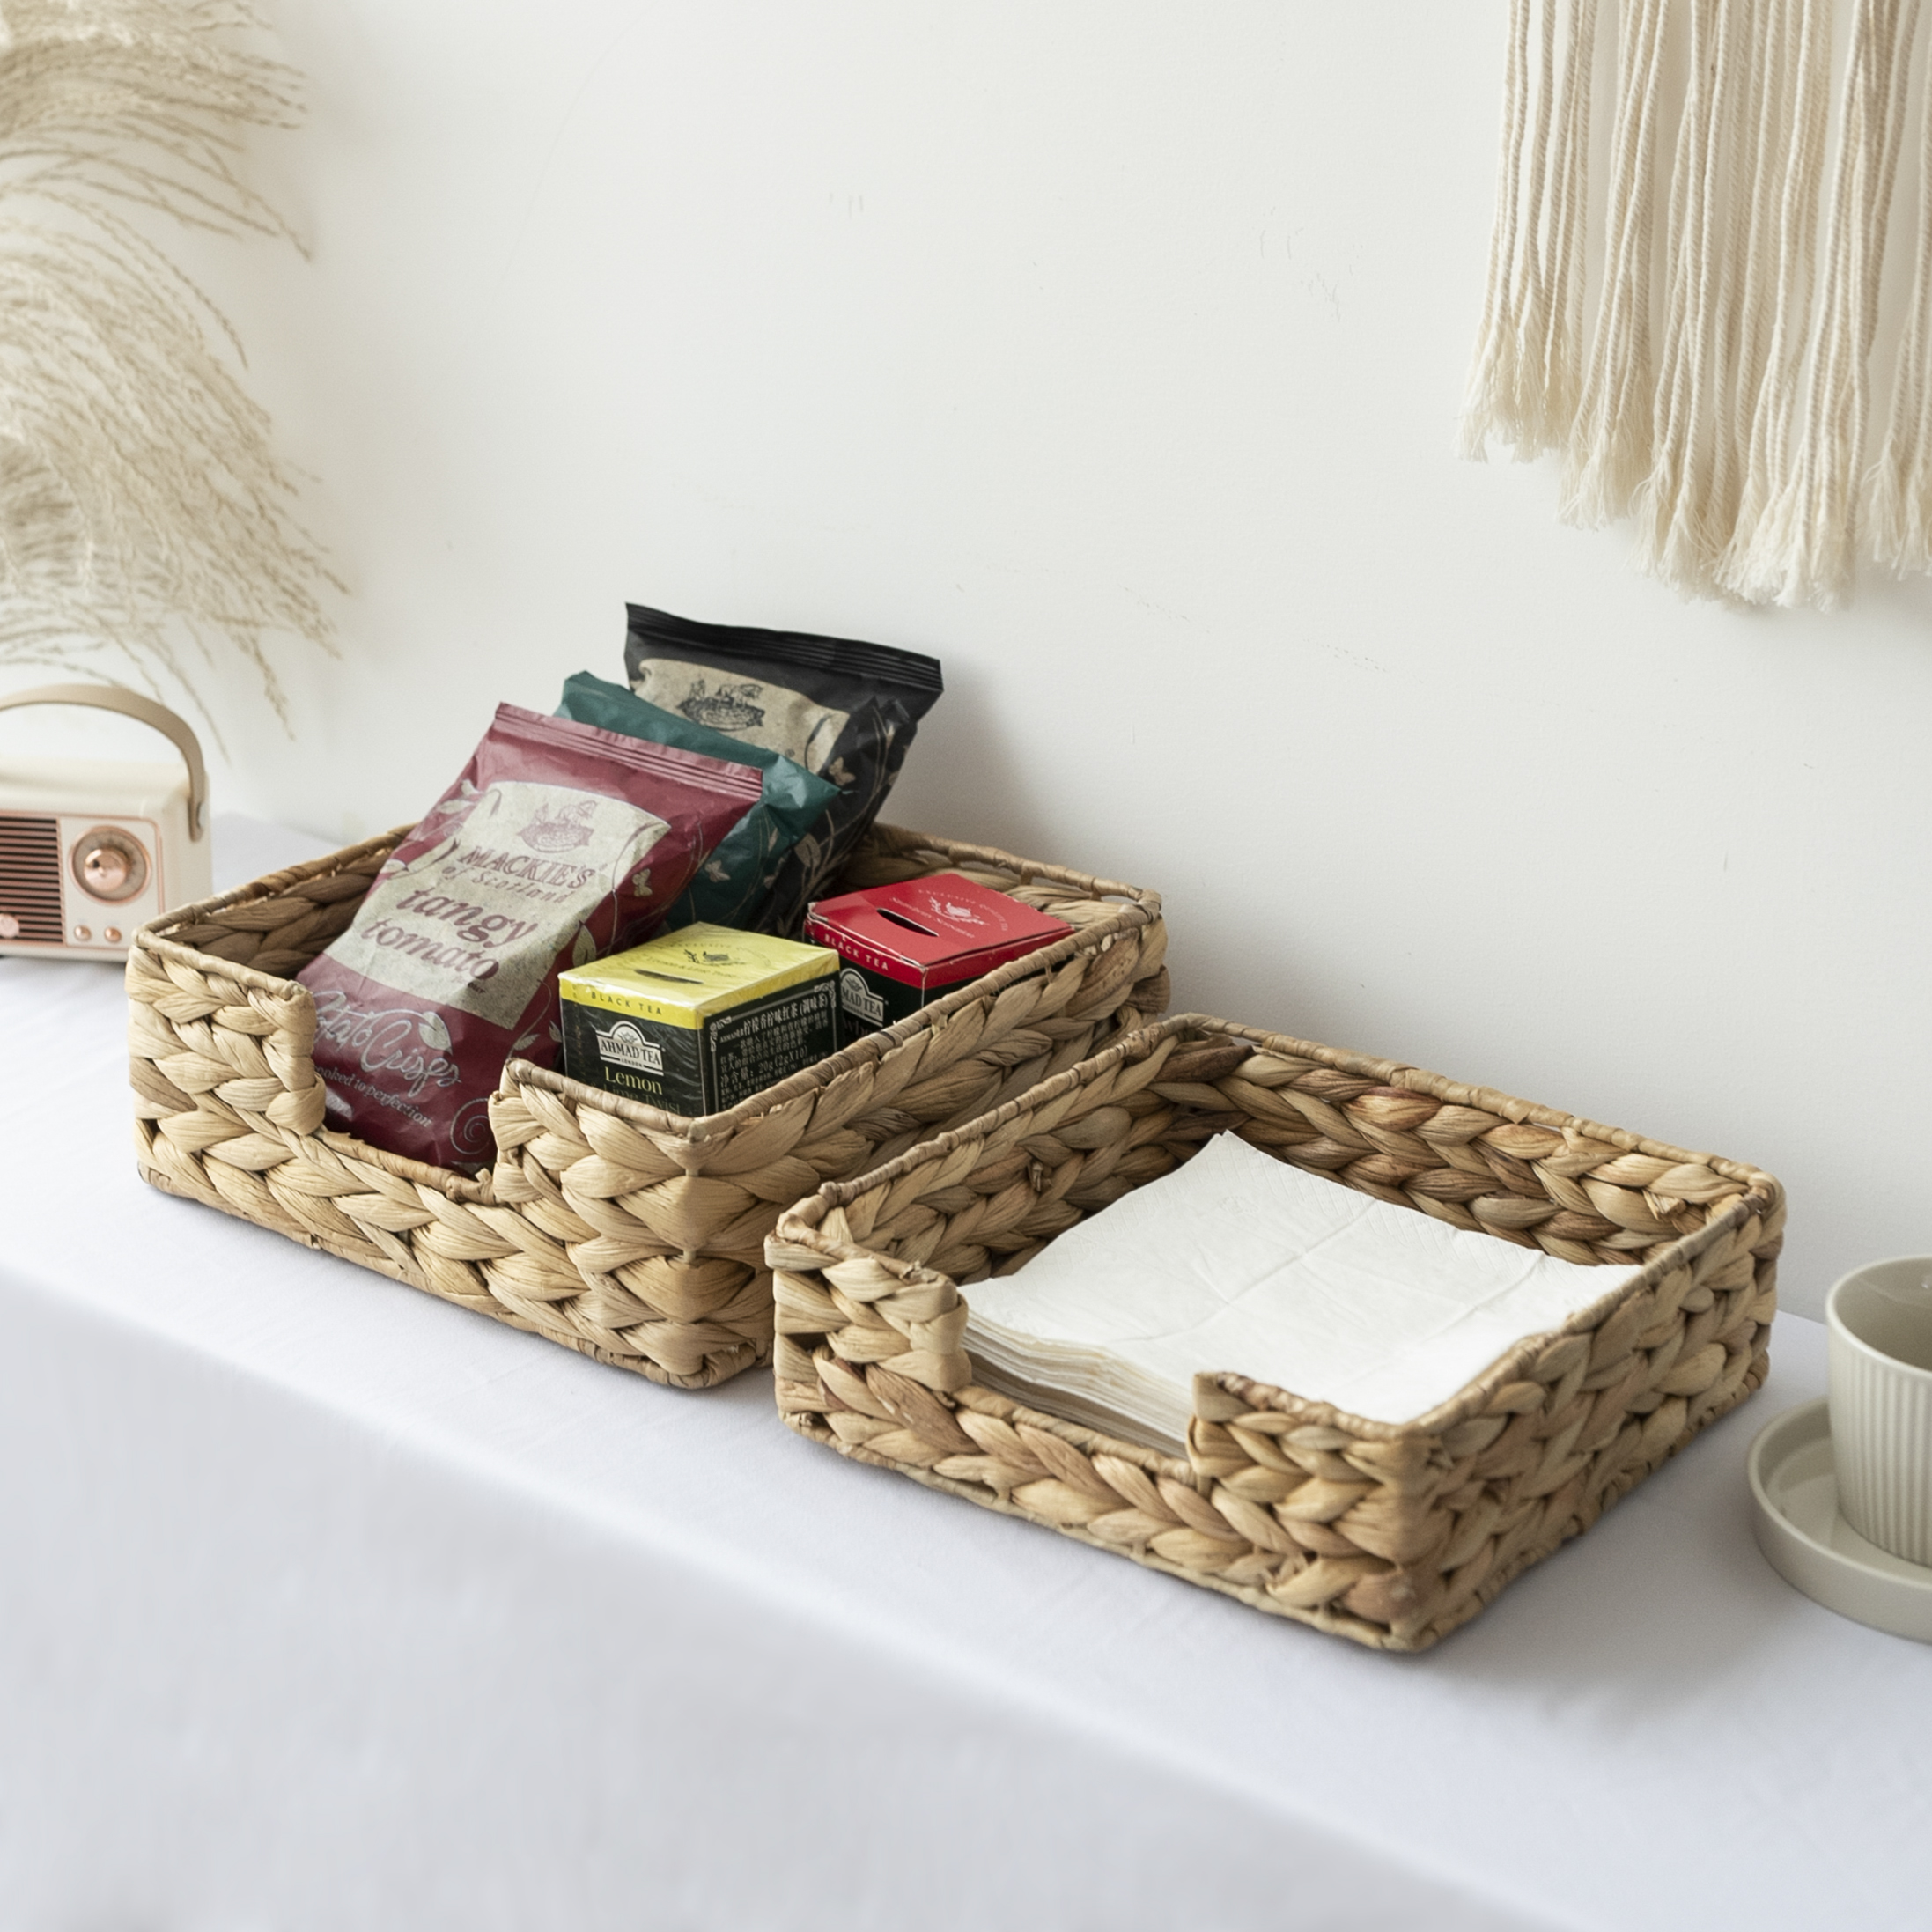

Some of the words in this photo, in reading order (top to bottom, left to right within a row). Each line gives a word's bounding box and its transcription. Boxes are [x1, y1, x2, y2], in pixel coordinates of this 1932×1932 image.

[441, 866, 474, 881] of
[472, 871, 575, 903] Scotland
[457, 845, 596, 889] MACKIE'S
[396, 887, 539, 948] tangy
[361, 918, 499, 980] tomato
[824, 933, 859, 959] BLACK
[865, 954, 889, 971] TEA
[591, 991, 630, 1008] BLACK
[638, 1002, 662, 1015] TEA
[842, 986, 862, 1007] MAD
[863, 997, 881, 1017] TEA
[601, 1039, 640, 1059] AHMAD
[641, 1048, 661, 1066] TEA
[314, 1066, 356, 1087] ooked
[354, 1079, 366, 1092] to
[363, 1084, 433, 1128] perfection
[605, 1066, 663, 1095] Lemon
